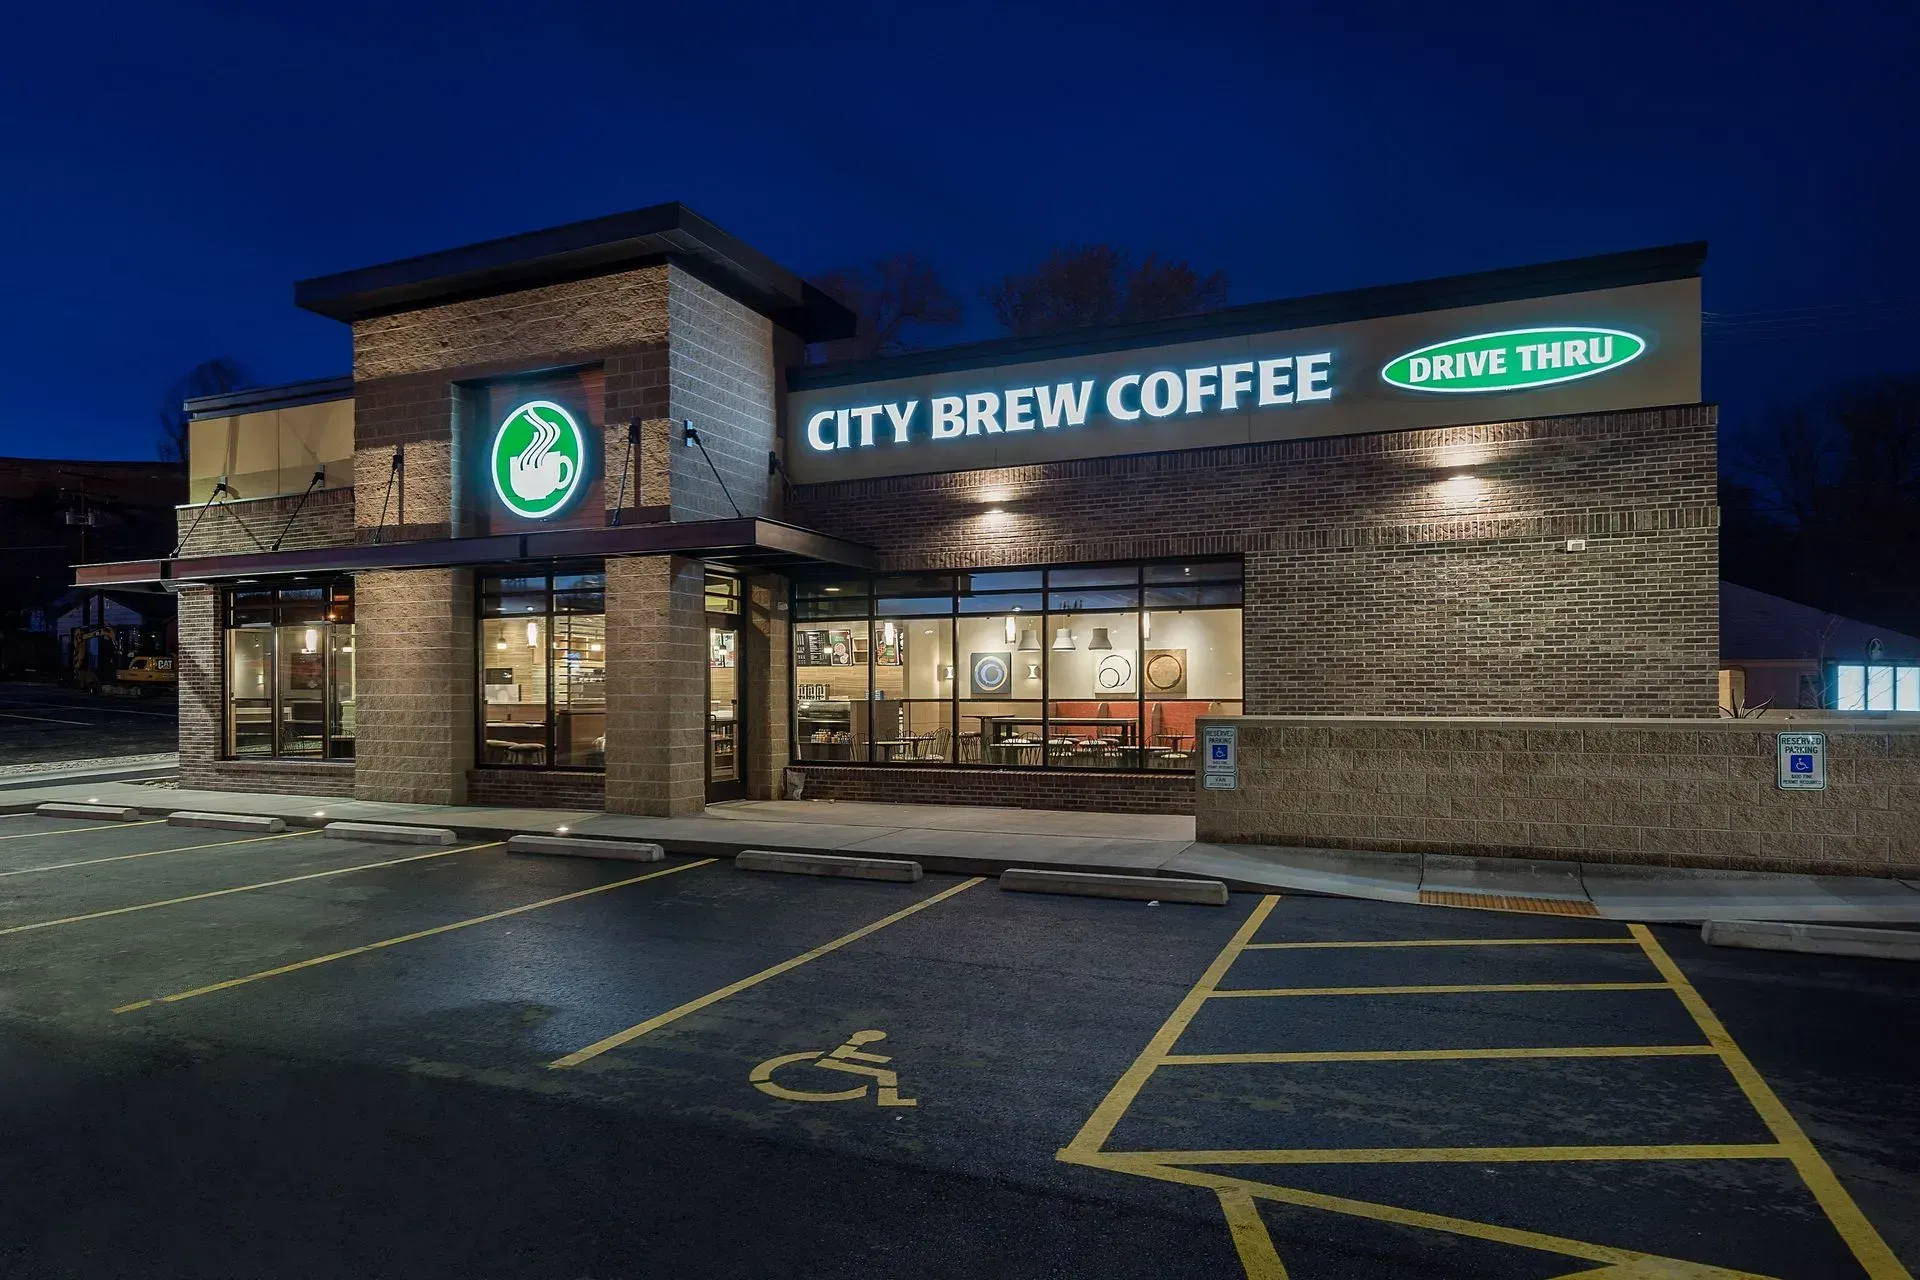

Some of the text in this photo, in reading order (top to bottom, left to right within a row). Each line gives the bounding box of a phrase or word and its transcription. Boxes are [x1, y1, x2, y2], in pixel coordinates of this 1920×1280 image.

[1409, 336, 1613, 383] DRIVE THRU
[807, 352, 1333, 451] CITY BREW COFFEE
[158, 660, 172, 669] CAT
[1781, 737, 1821, 745] RESERVED
[1785, 746, 1818, 754] PARKING
